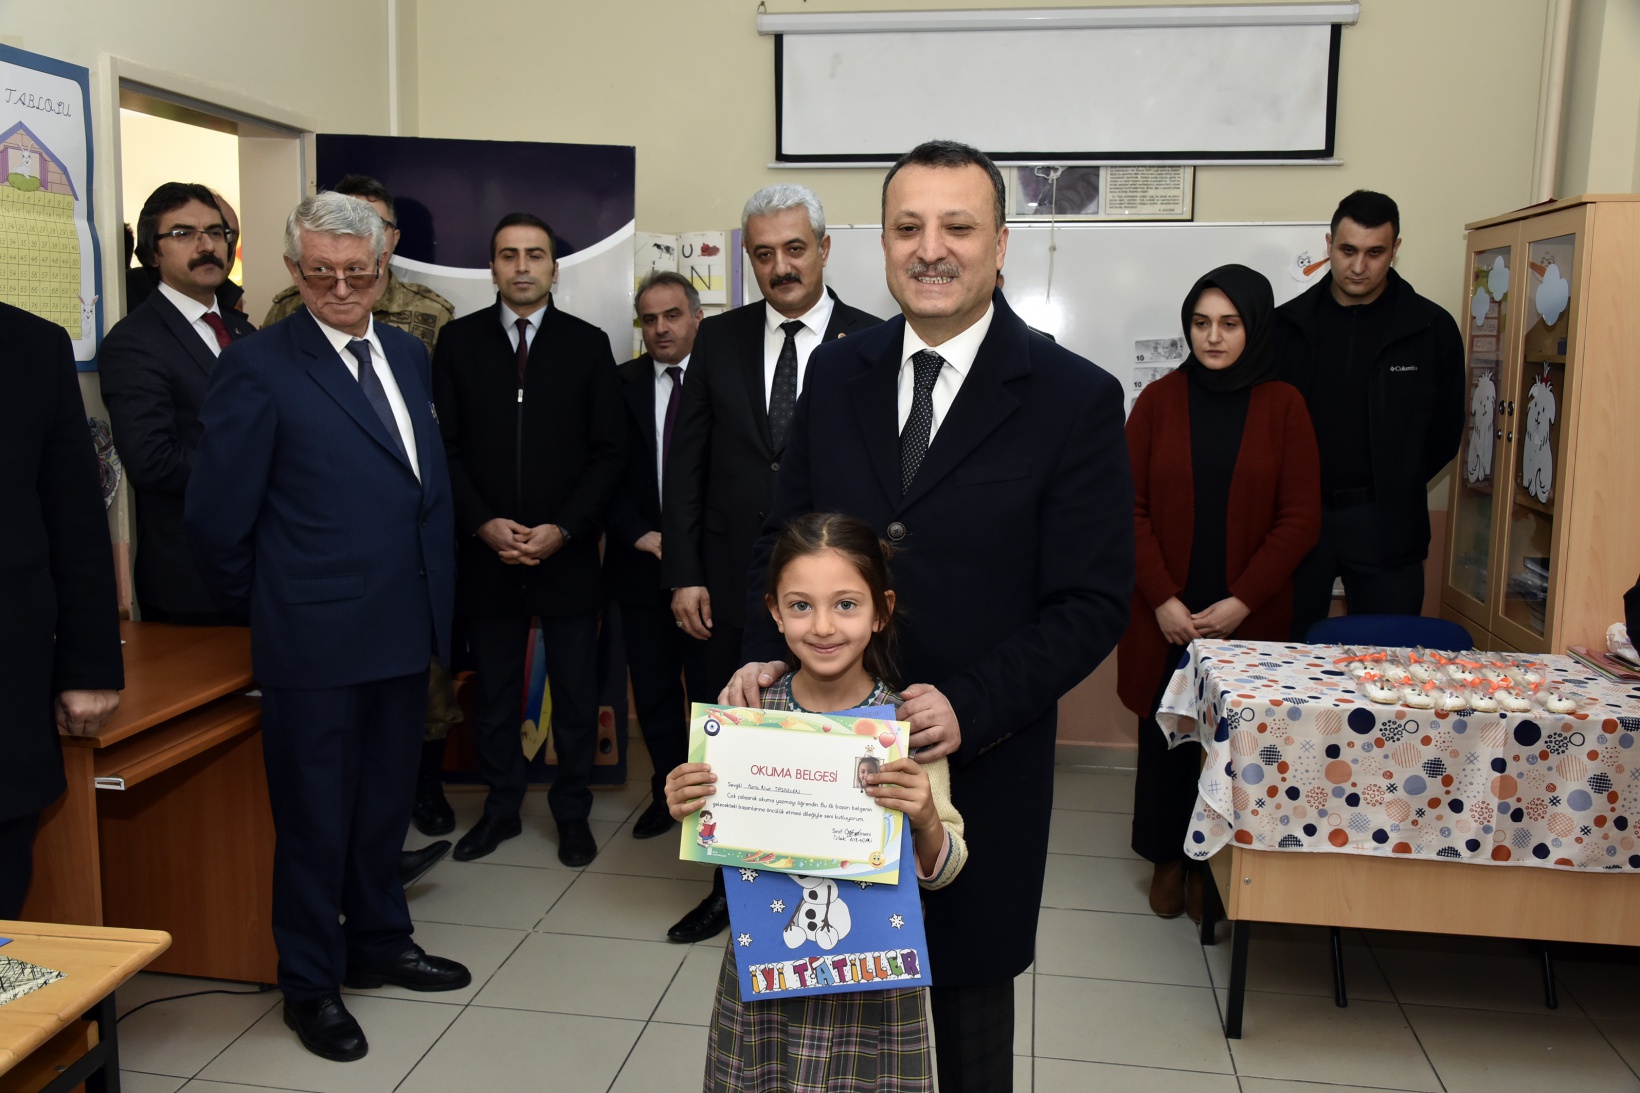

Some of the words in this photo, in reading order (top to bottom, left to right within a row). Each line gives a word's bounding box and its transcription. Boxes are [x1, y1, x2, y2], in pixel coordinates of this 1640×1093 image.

[31, 240, 38, 248] 36
[52, 242, 58, 250] 38
[52, 272, 58, 280] 58
[691, 265, 710, 290] N
[62, 317, 69, 325] 89
[1136, 354, 1145, 362] 10
[750, 764, 792, 778] OKUMA
[795, 768, 838, 782] BELGESİ
[728, 781, 743, 789] Sevgili
[738, 794, 757, 802] çalışarak
[776, 799, 796, 807] yazmayı
[835, 804, 851, 812] başarı
[852, 805, 872, 814] belgenin
[766, 806, 784, 815] öncülük
[803, 811, 823, 819] dileğiyle
[792, 948, 921, 988] TATİLLER
